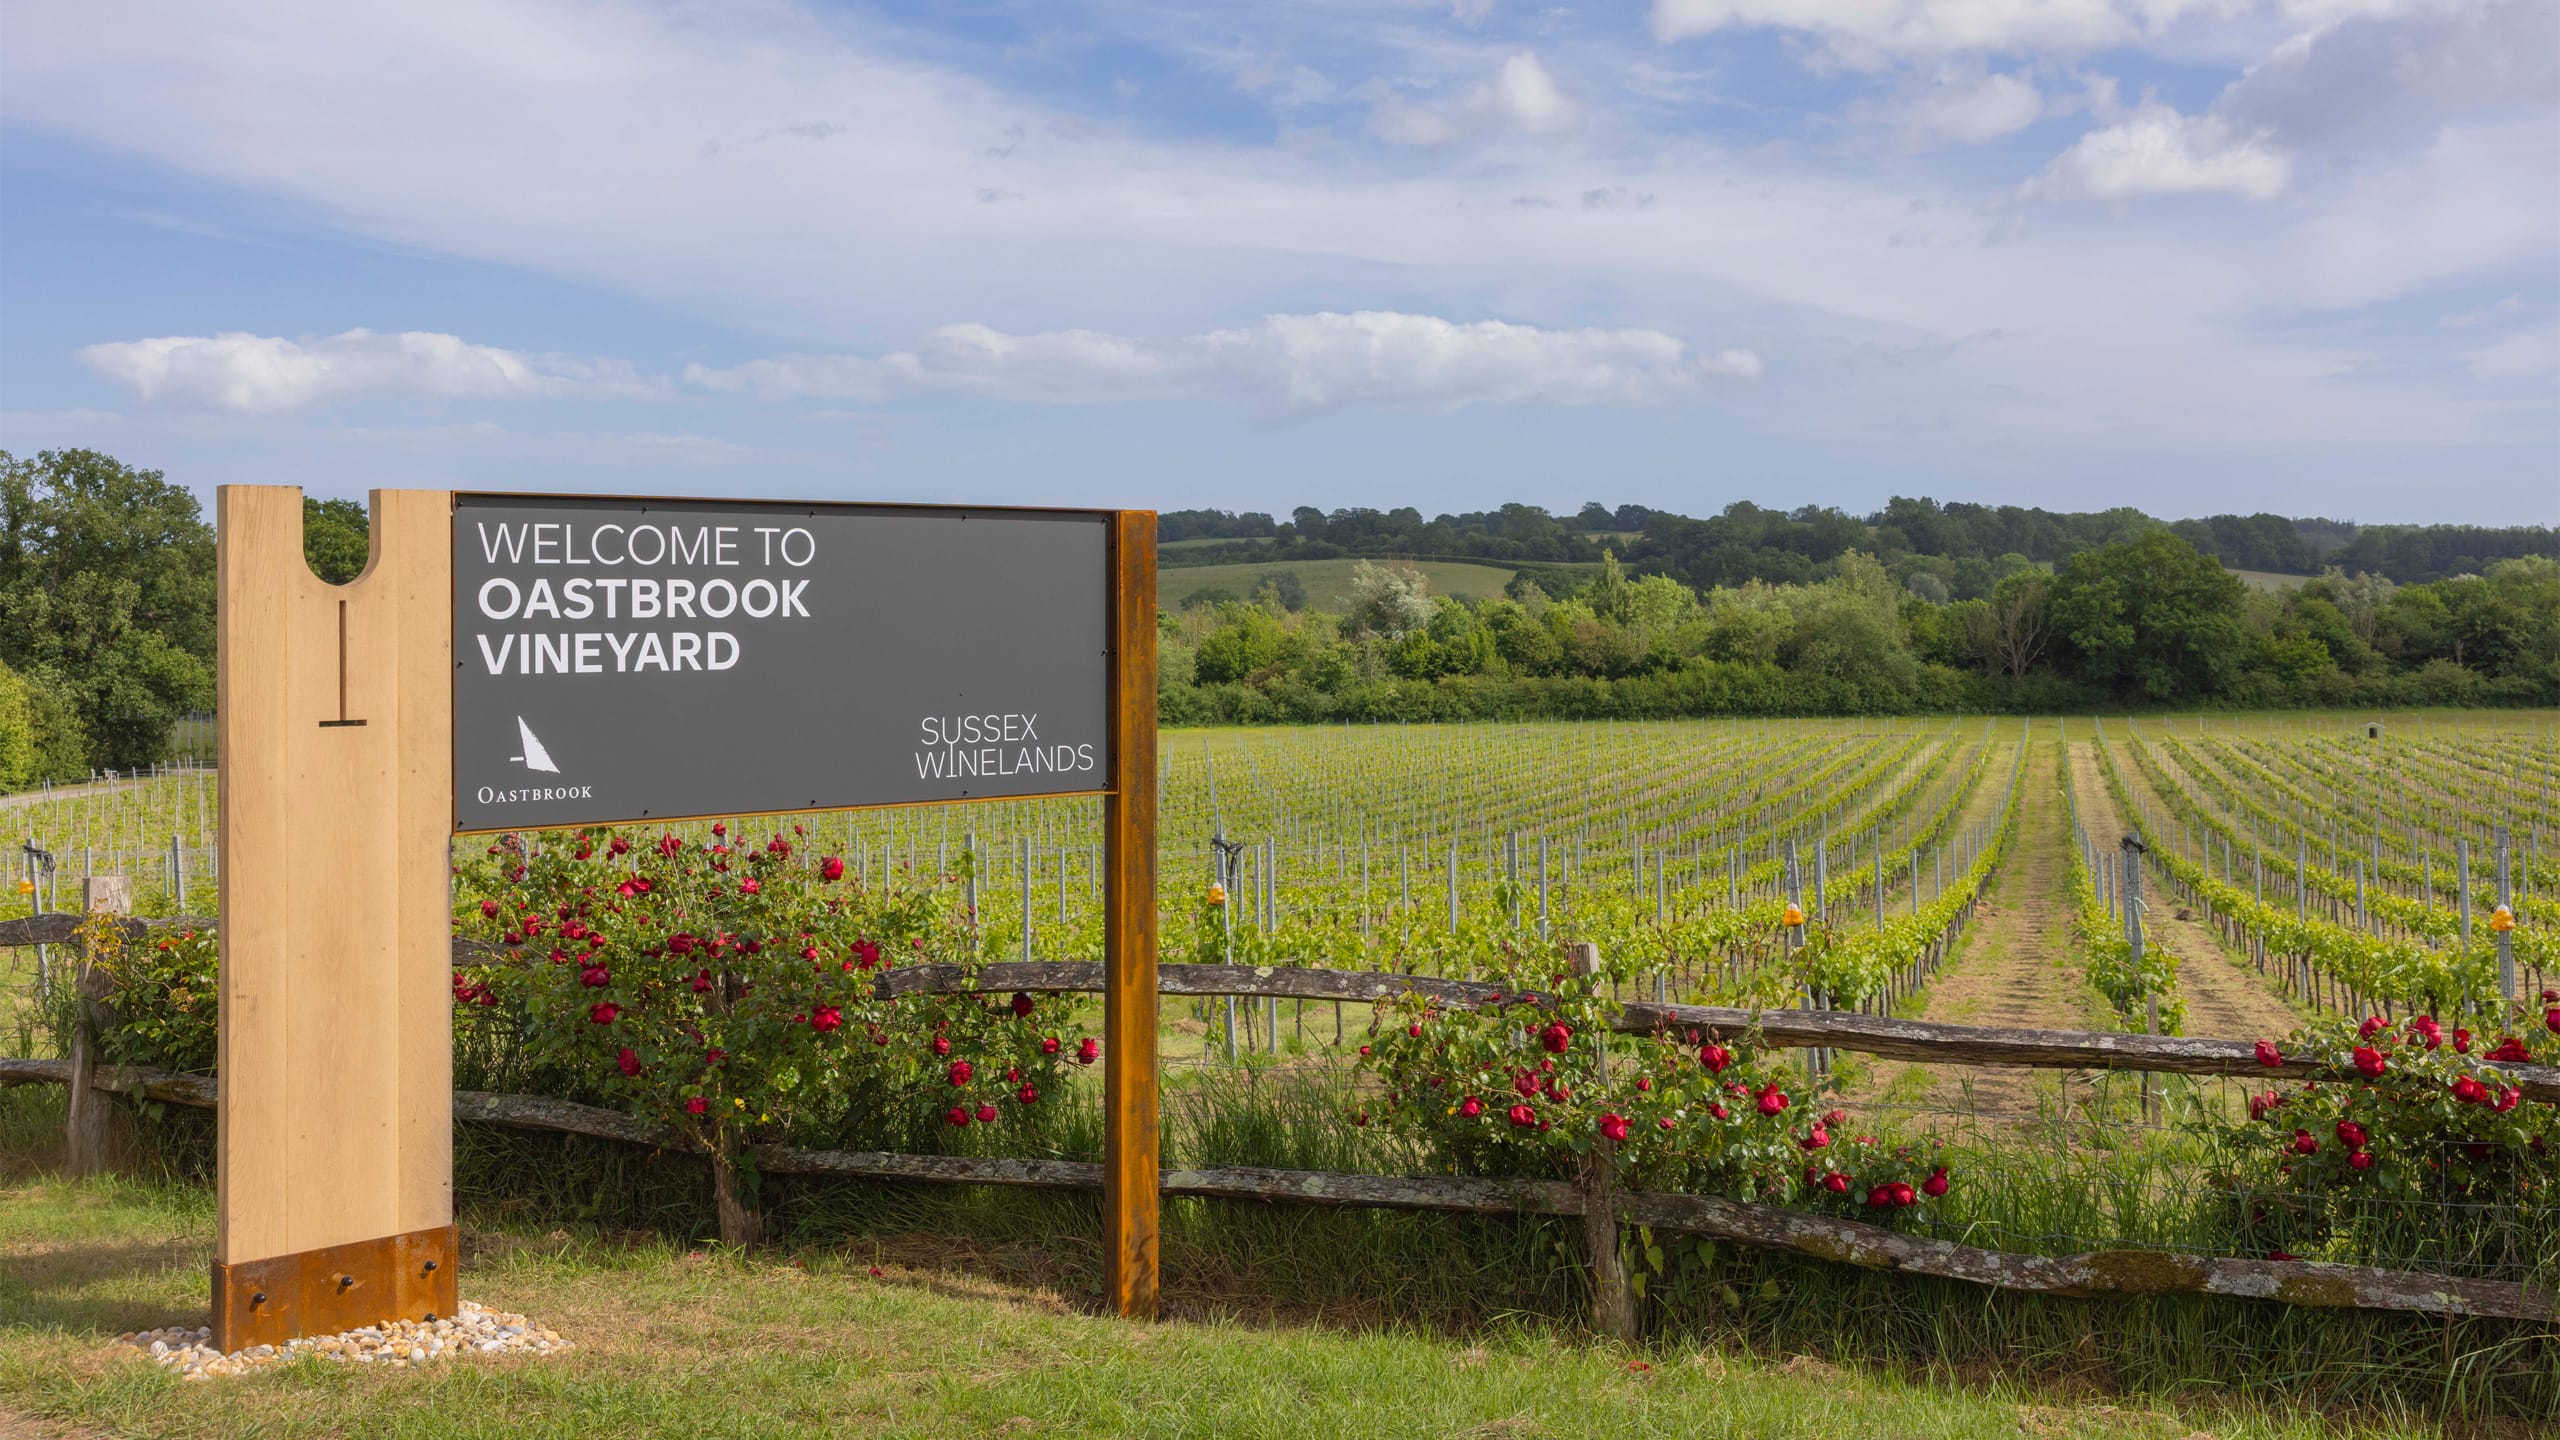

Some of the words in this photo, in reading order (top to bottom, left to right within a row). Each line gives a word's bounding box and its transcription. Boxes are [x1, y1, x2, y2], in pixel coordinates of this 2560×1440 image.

[477, 521, 740, 566] WELCOME
[753, 527, 816, 567] TO
[478, 577, 811, 620] OASTBROOK
[476, 631, 741, 676] VINEYARD
[921, 713, 1038, 746] SUSSEX
[915, 743, 1094, 780] WINELANDS
